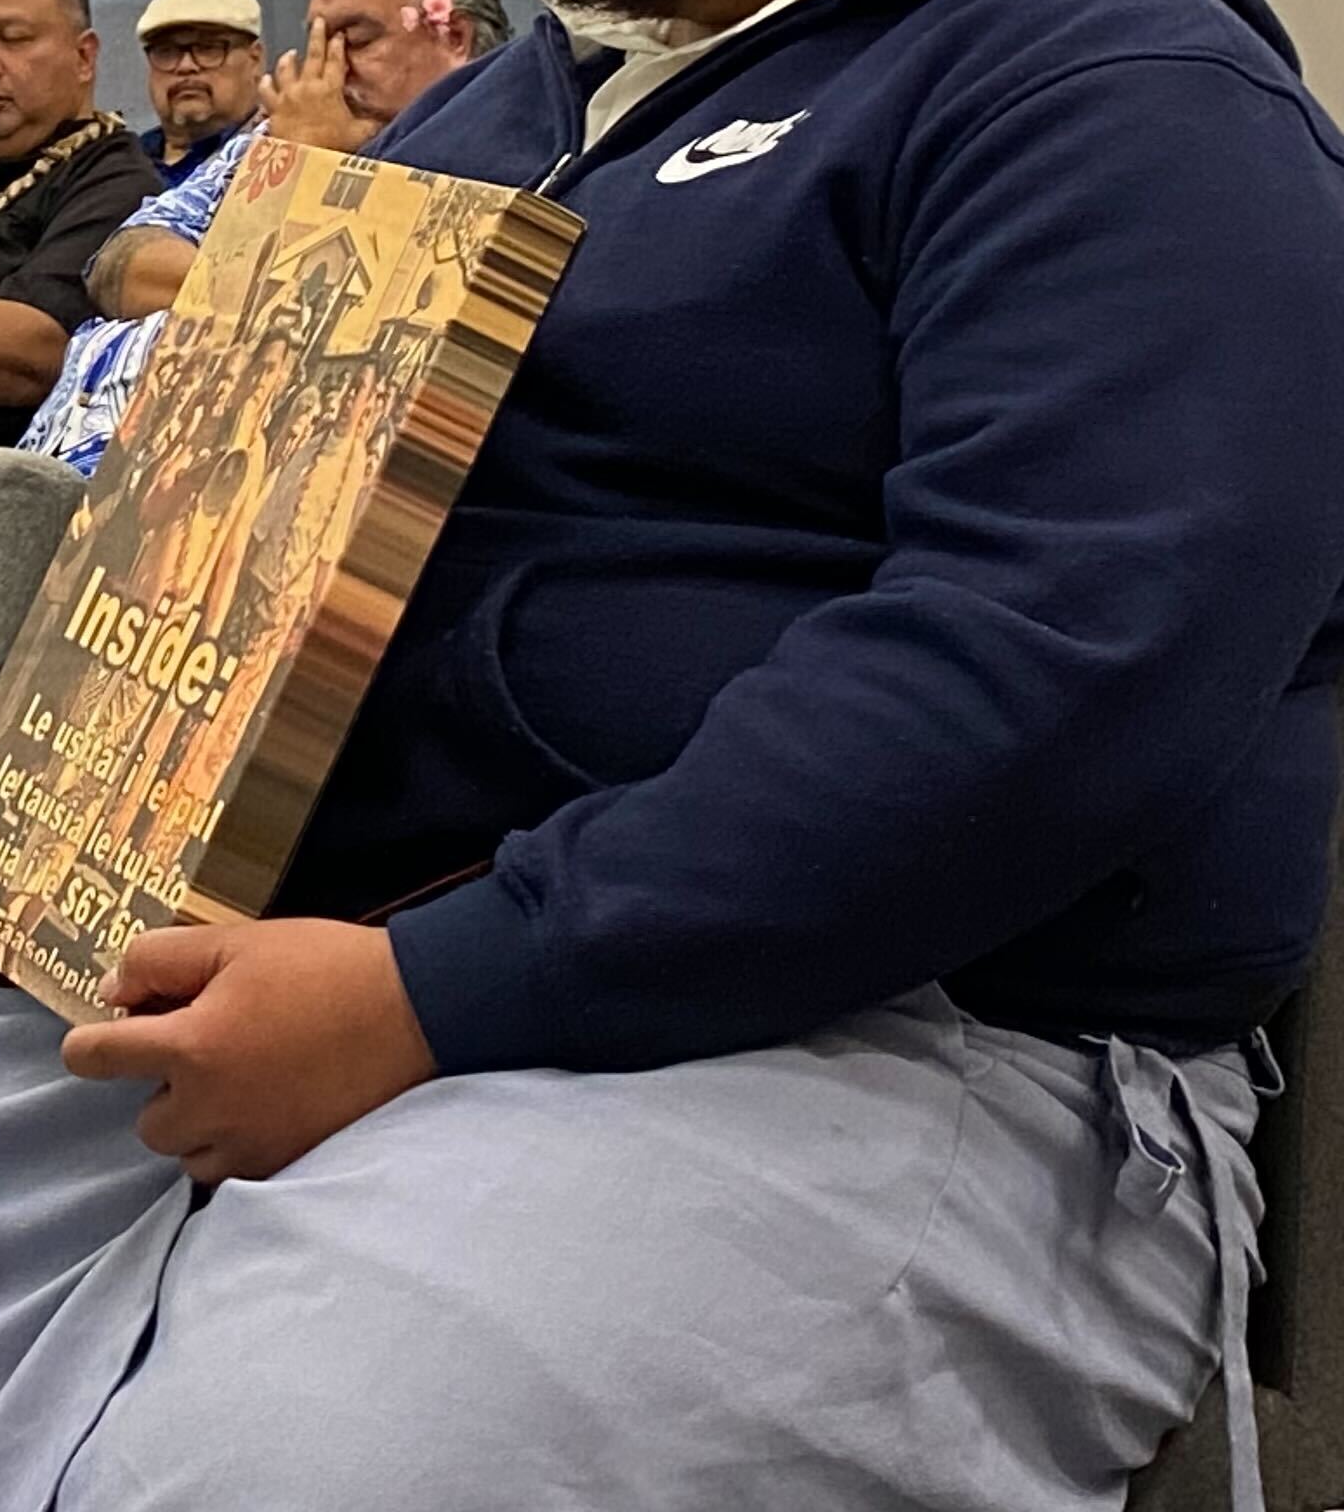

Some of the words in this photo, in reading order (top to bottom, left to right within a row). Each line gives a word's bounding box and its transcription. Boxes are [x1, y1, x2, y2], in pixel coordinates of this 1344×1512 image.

[64, 565, 238, 717] Inside:
[20, 692, 53, 741] Le
[52, 721, 128, 786] usitai
[122, 753, 145, 795] i
[139, 763, 169, 813] le
[165, 794, 225, 843] pul
[18, 775, 86, 843] tausia
[85, 816, 112, 862] le
[22, 849, 40, 885] i
[30, 858, 61, 903] le
